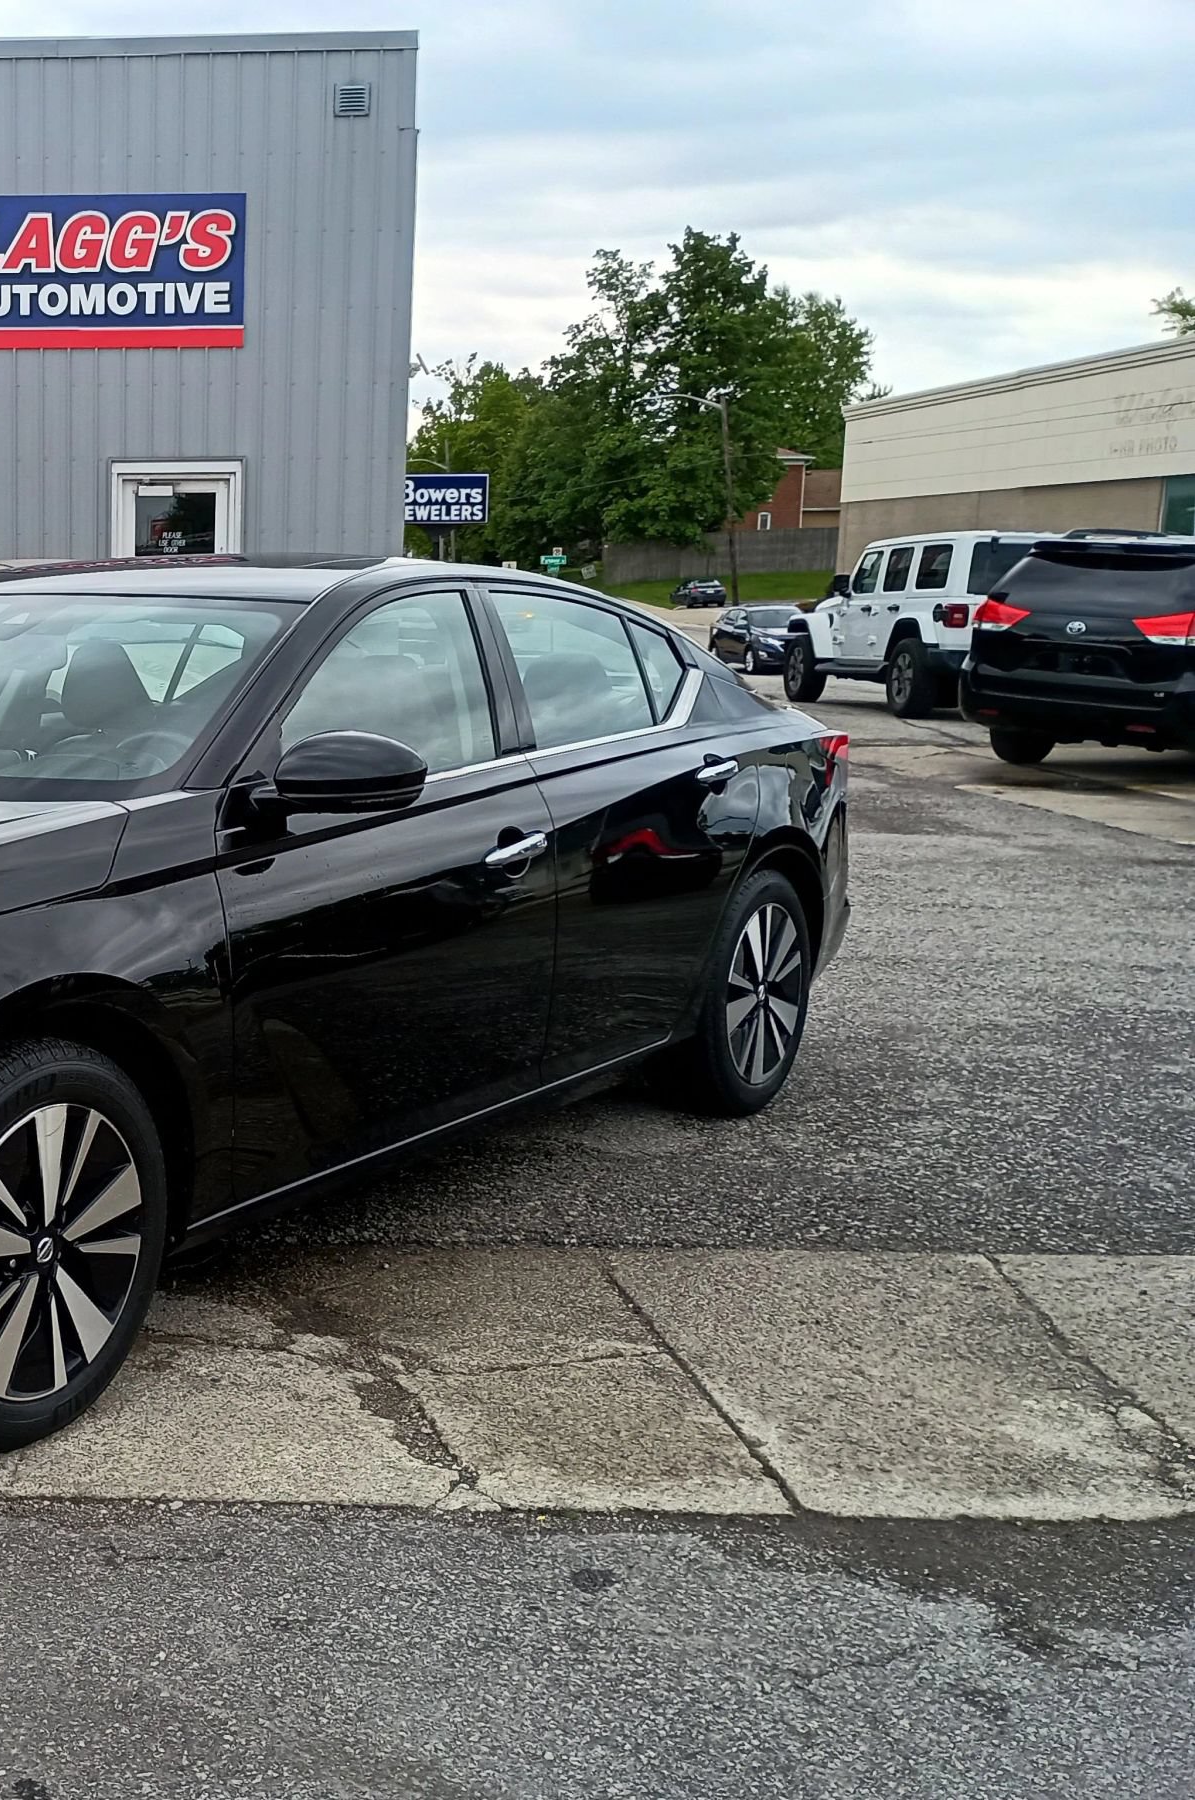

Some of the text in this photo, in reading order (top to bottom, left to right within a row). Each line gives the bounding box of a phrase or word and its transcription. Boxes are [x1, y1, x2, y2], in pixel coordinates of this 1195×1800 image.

[404, 480, 483, 503] Bowers
[404, 505, 483, 521] EWELERS
[162, 531, 183, 539] PLEASE
